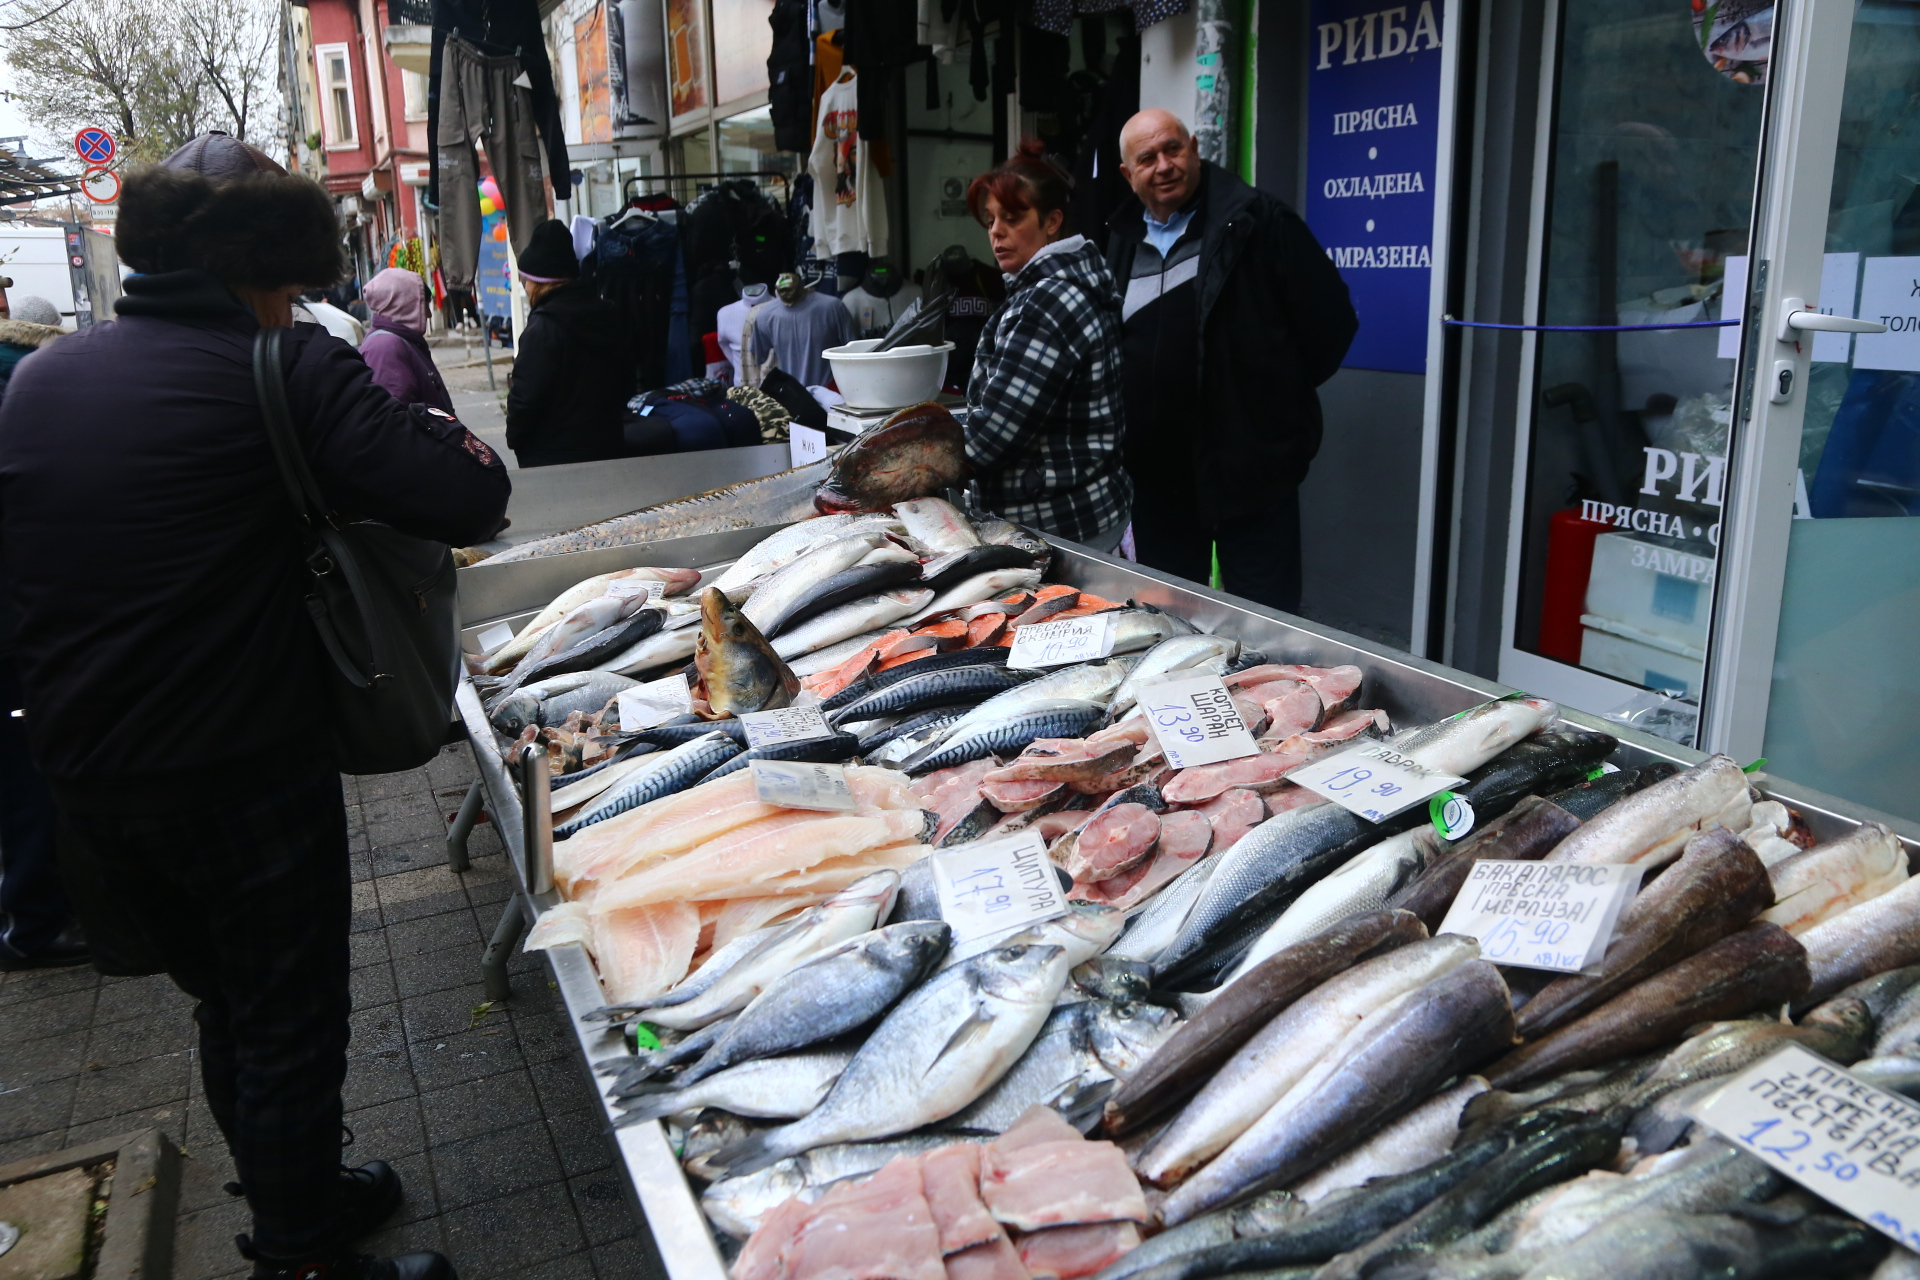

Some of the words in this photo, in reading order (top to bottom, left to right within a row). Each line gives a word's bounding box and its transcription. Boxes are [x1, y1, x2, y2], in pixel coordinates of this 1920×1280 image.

[1316, 0, 1443, 71] РИБА
[1333, 103, 1418, 135] ПРЯСНА
[1323, 171, 1425, 200] ОХЛАДЕНА
[1580, 499, 1686, 540] ПРЯСНА
[1017, 625, 1093, 645] СКУМРИЯ
[1019, 620, 1073, 637] ПРЕСНА
[1190, 692, 1229, 739] ШАРАН
[1209, 687, 1244, 732] КОТЛЕТ
[1010, 845, 1056, 912] ЦИПУРА
[1472, 863, 1608, 887] БАКАЛЯРОС
[1779, 1072, 1920, 1155] ЧИСТЕНА
[1805, 1065, 1920, 1131] ПРЕСНА
